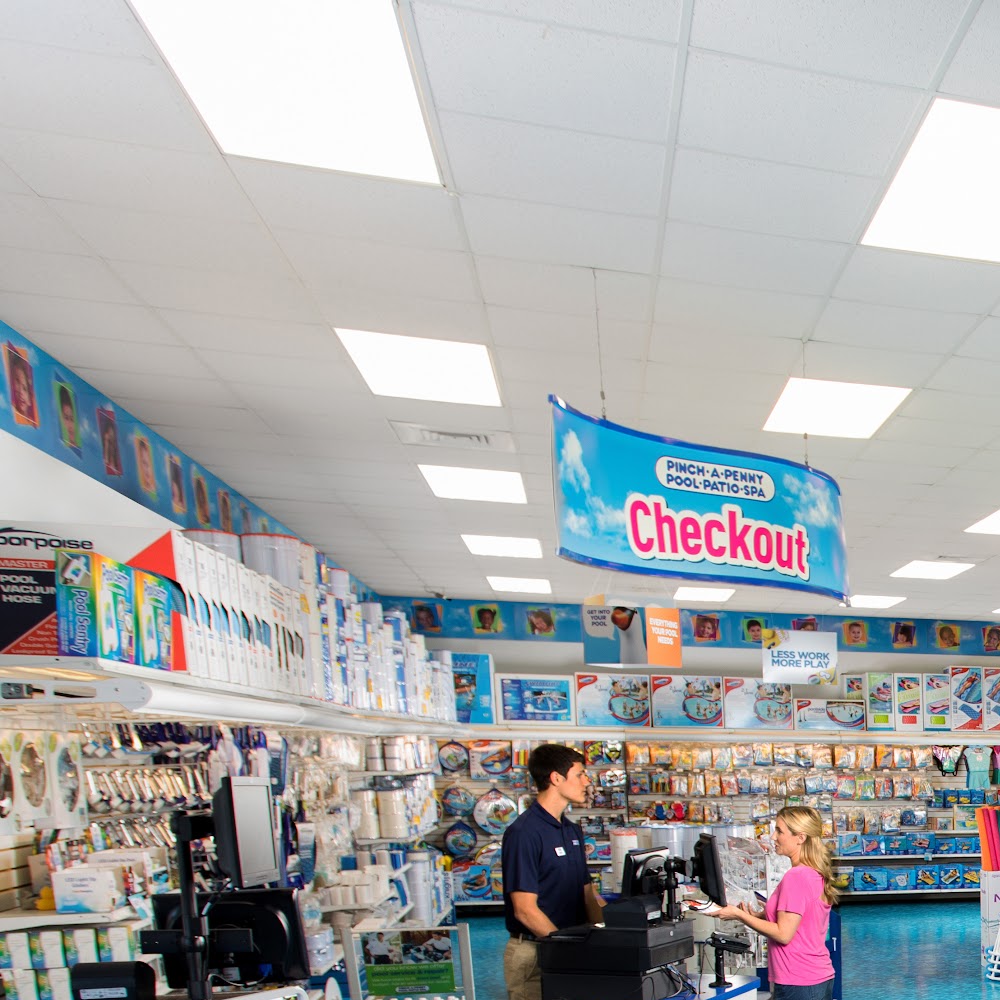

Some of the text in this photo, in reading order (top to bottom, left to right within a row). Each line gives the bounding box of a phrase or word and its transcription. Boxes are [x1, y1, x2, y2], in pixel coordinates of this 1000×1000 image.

[630, 500, 806, 574] Checkout
[0, 574, 39, 584] POOL
[2, 594, 43, 604] HOSE
[70, 589, 91, 655] Pool Sentry
[770, 650, 830, 661] LESS WORK
[771, 658, 830, 669] MORE PLAY
